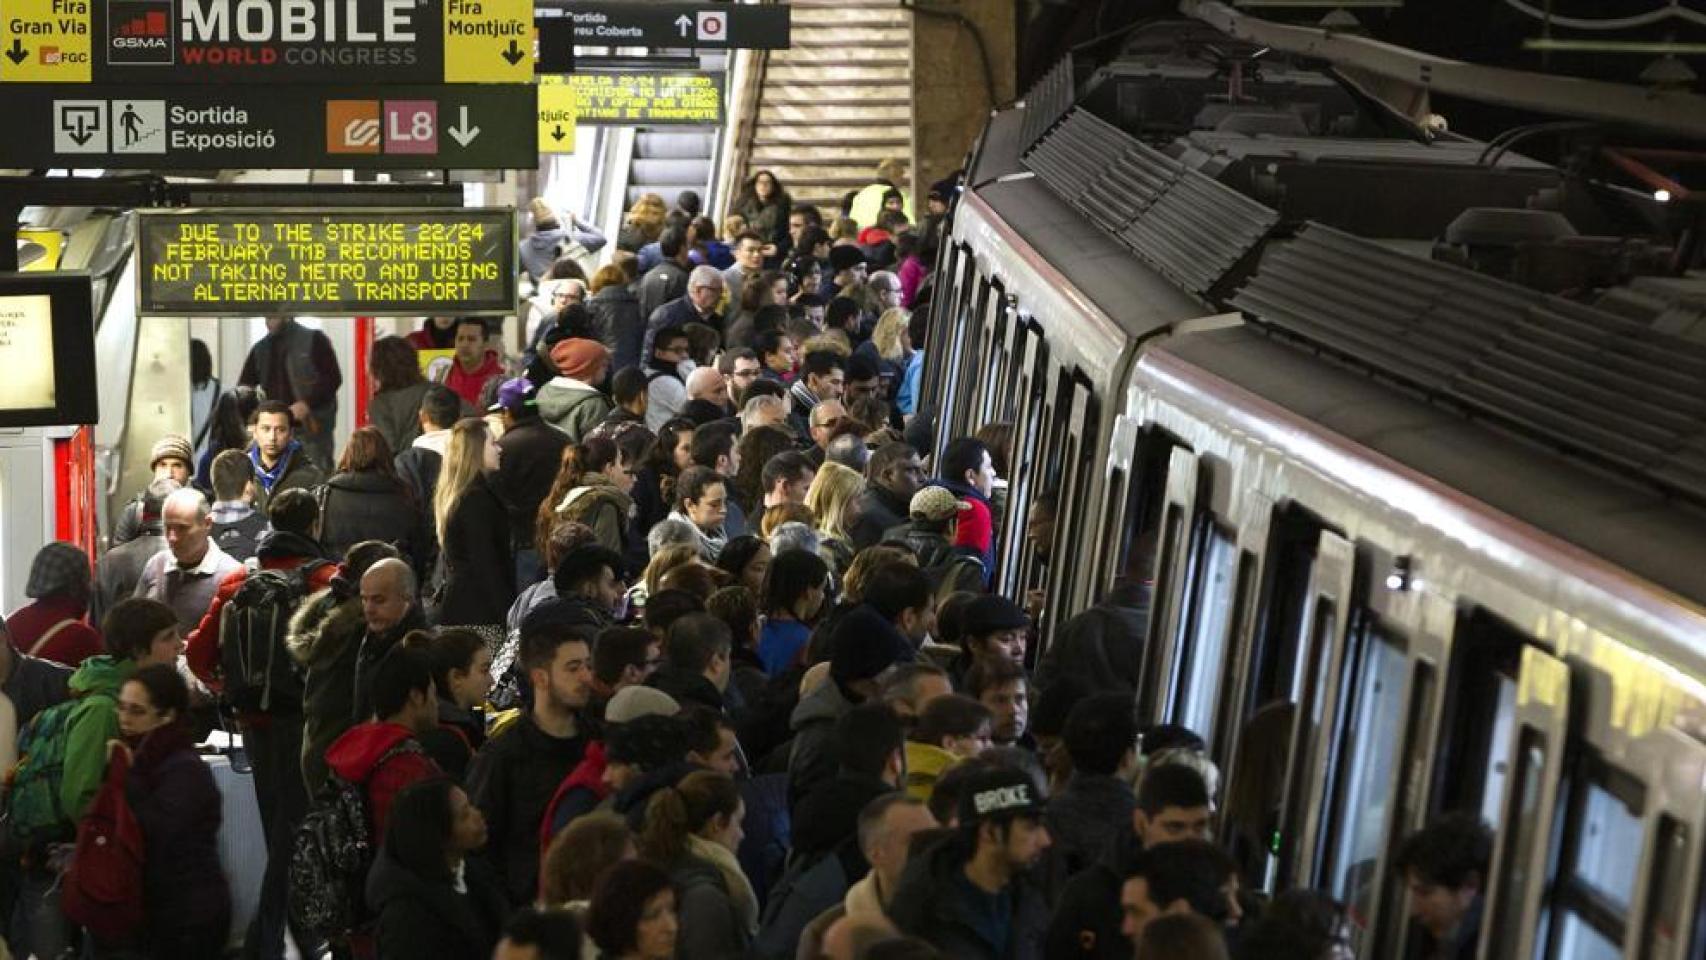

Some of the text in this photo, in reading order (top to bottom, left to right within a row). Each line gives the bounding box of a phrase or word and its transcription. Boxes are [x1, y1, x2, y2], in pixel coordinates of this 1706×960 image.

[52, 0, 87, 15] Fira
[449, 0, 482, 15] Fira
[182, 0, 416, 42] MOBILE
[566, 12, 607, 23] ortida
[10, 19, 87, 34] Gran Via
[449, 20, 525, 37] Montjuïc
[596, 26, 643, 37] Coberta
[113, 38, 167, 48] GSMA
[61, 54, 88, 63] FGC
[182, 48, 417, 65] WORLD CONGRESS
[170, 106, 249, 124] Sortida
[390, 111, 434, 141] L8
[171, 129, 276, 151] Exposició
[180, 224, 485, 242] DUE TO THE STRIKE 22/24
[166, 243, 471, 261] FEBRUARY TMB RECOMMENDS
[153, 263, 498, 281] NOT TAKING METRO AND USING
[193, 282, 471, 301] ALTERNATIVE TRANSPORT
[974, 784, 1031, 813] BROKE
